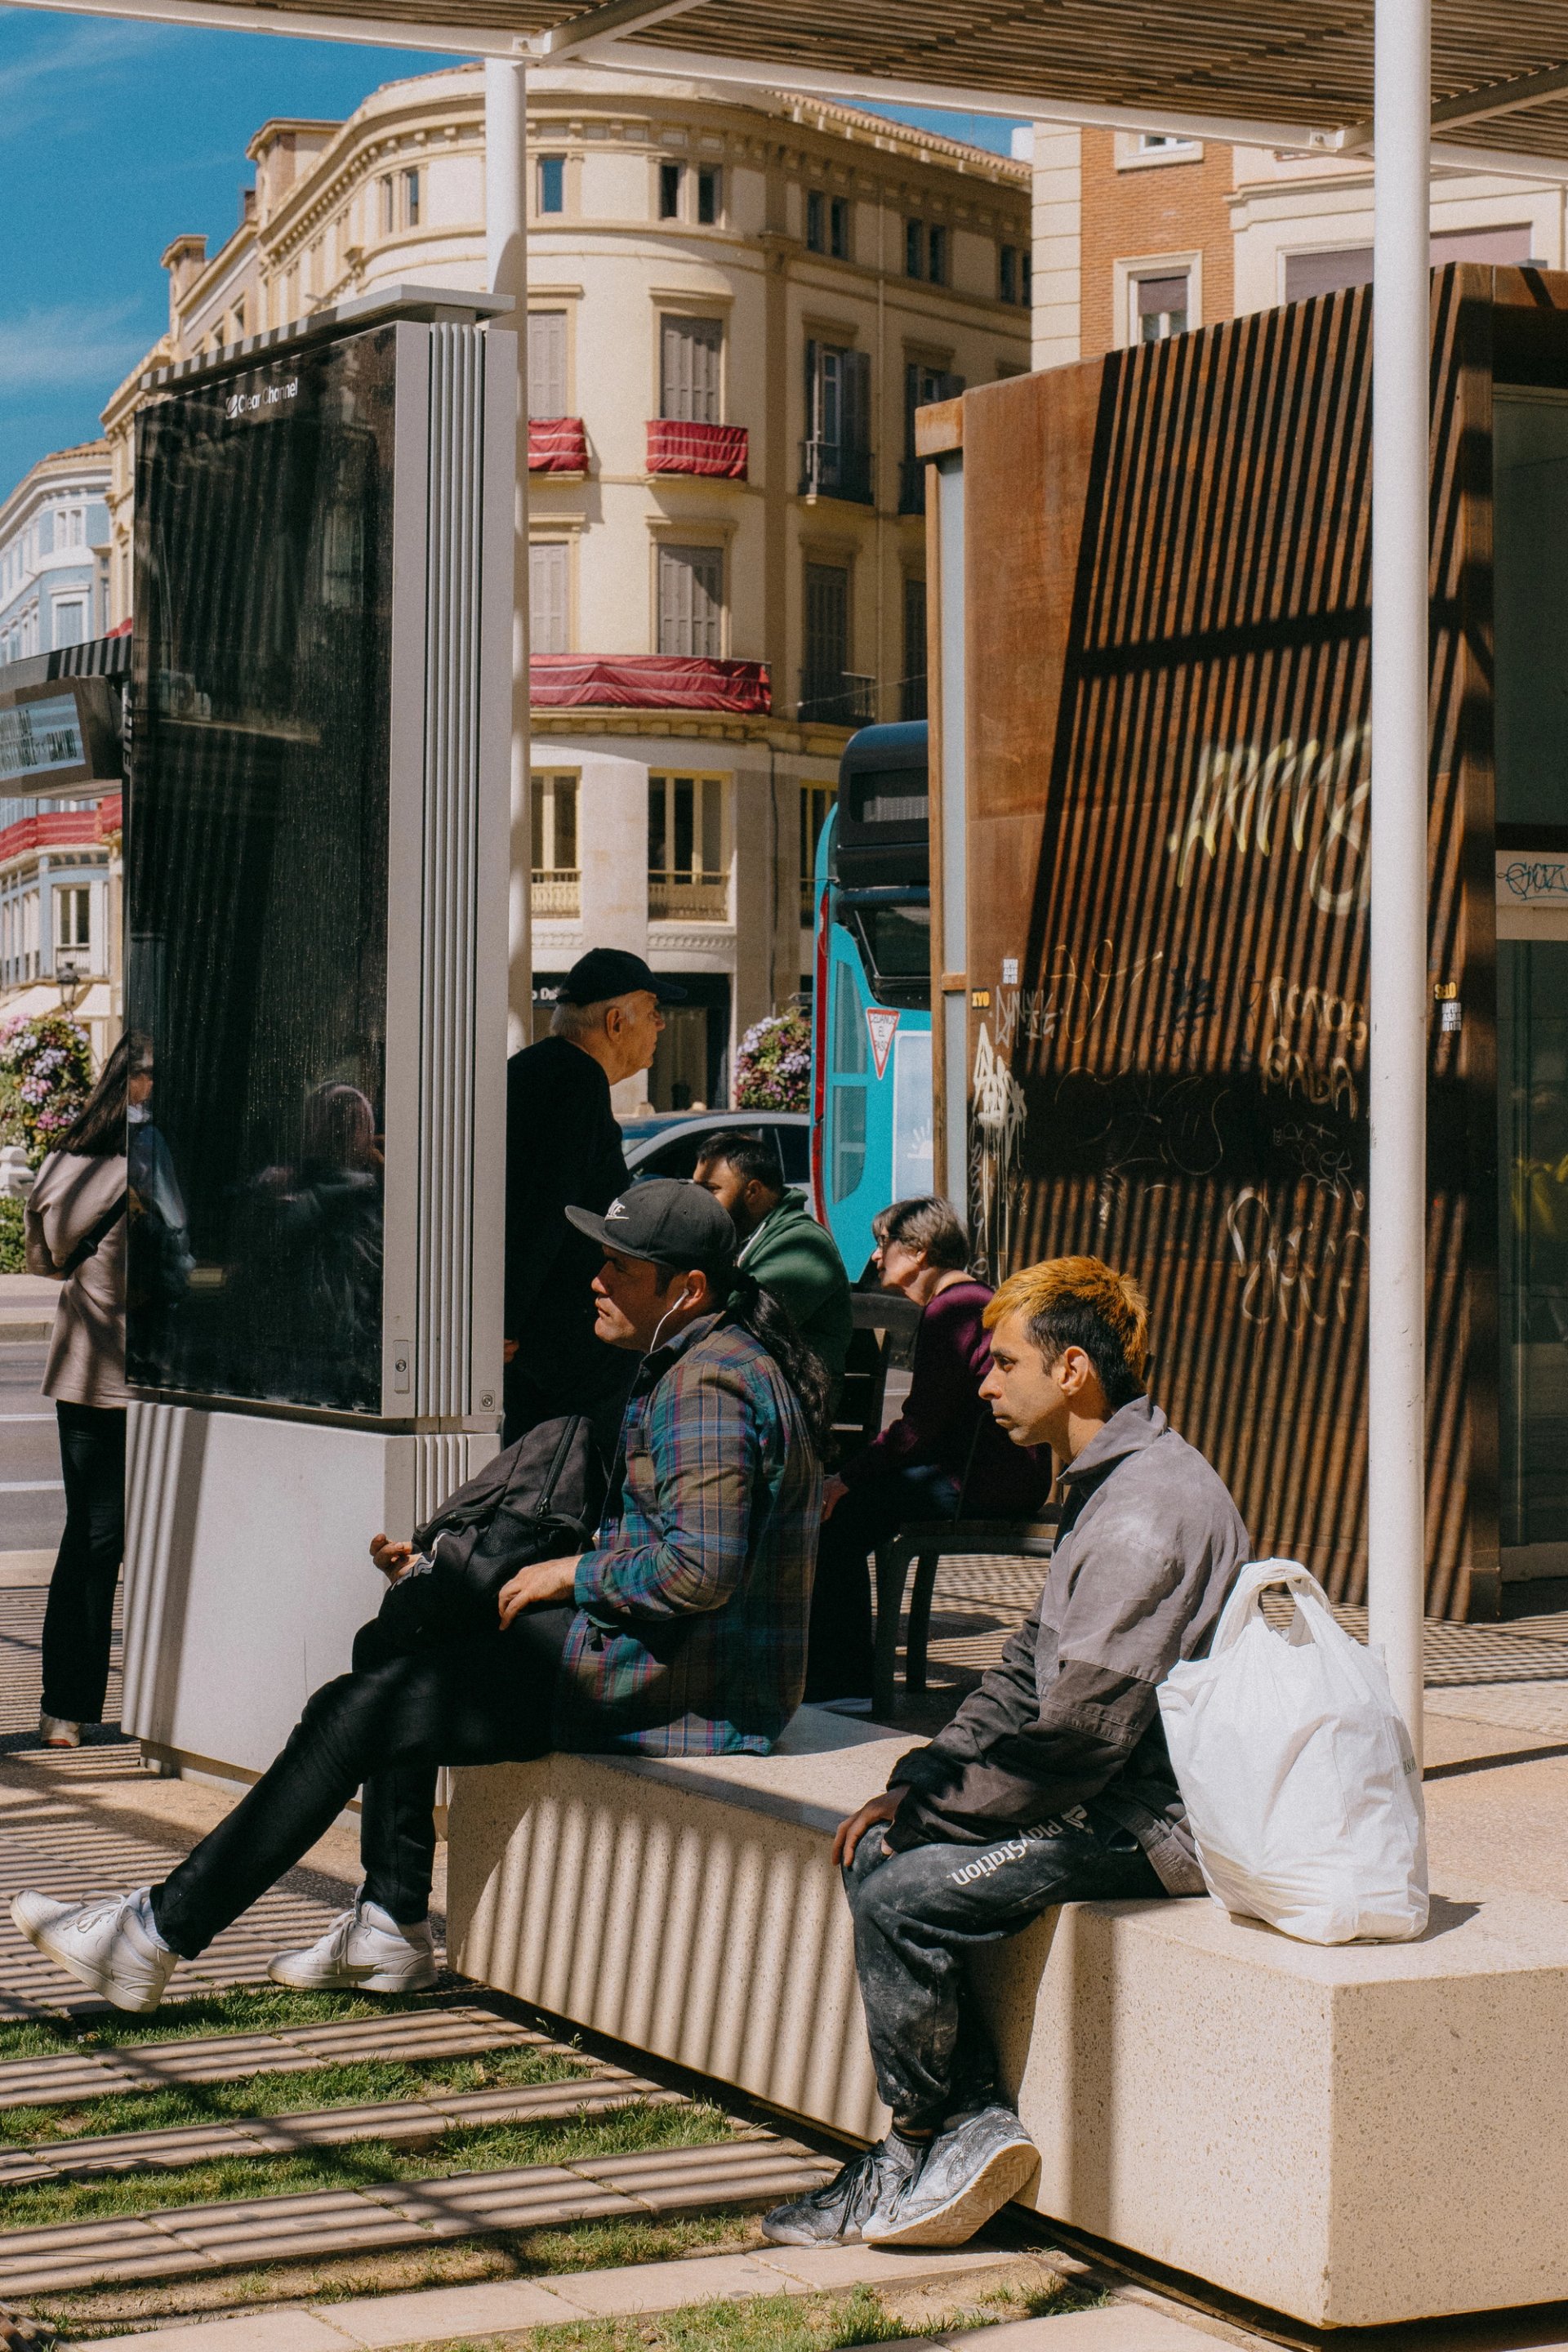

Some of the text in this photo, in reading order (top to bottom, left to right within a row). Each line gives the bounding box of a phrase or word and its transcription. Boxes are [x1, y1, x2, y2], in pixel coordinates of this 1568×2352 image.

[238, 376, 299, 414] Clear Channel
[950, 1818, 1063, 1886] PlayStation
